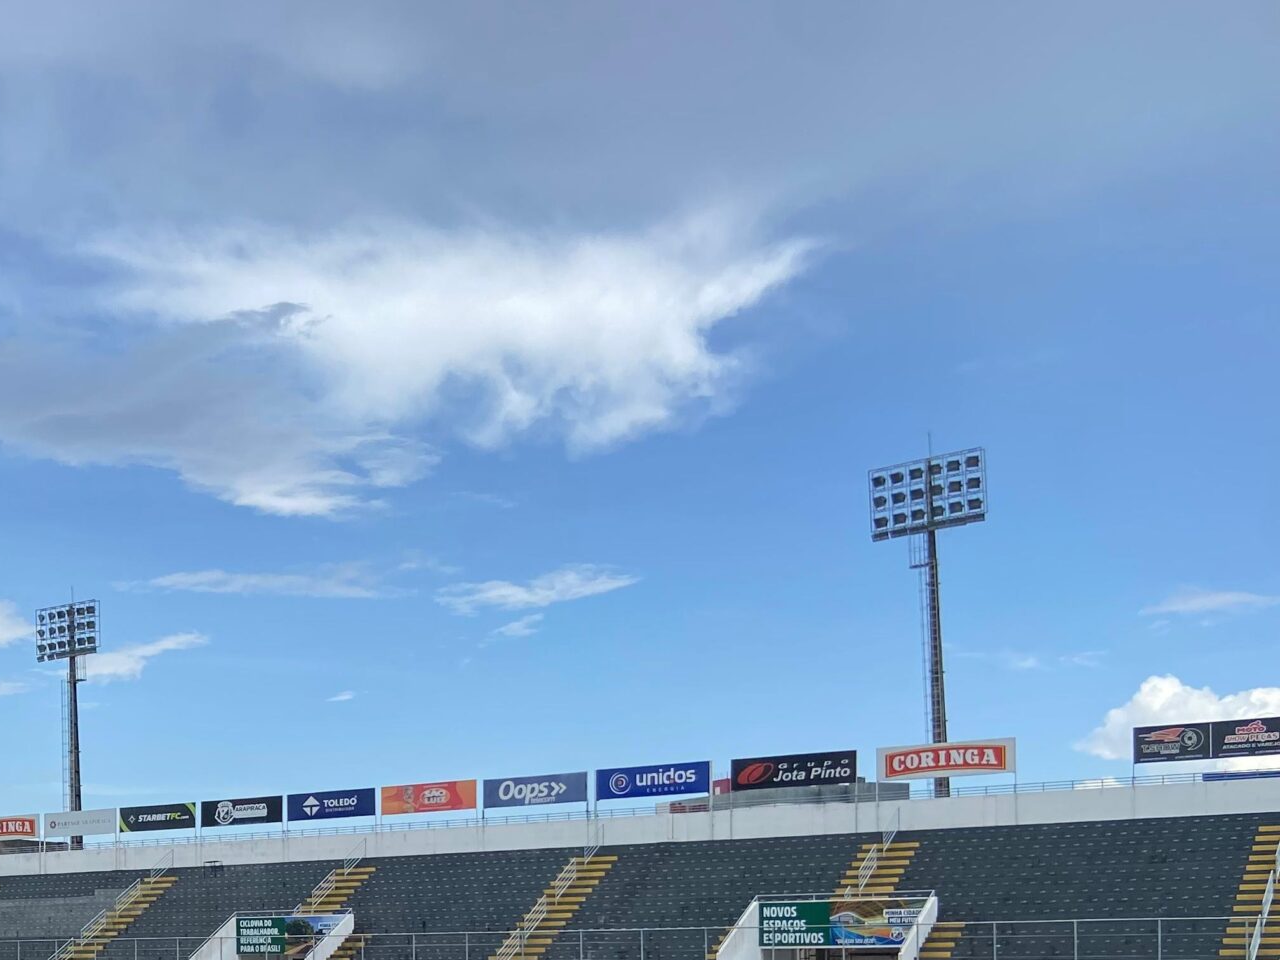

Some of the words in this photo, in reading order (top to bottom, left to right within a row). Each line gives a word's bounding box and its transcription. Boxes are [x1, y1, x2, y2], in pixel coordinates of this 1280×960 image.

[1235, 726, 1265, 734] MOTO
[1224, 734, 1248, 743] SHOW
[892, 748, 998, 772] CORINGA
[635, 767, 696, 787] unidos
[773, 769, 806, 783] Jota
[809, 766, 851, 780] Pinto
[498, 780, 550, 804] Oops
[323, 798, 357, 807] TOLEDO
[763, 906, 797, 918] NOVOS
[240, 919, 264, 927] CICLOVIA
[264, 919, 272, 927] DO
[763, 919, 806, 932] ESPAÇOS
[763, 932, 824, 944] ESPORTIVOS
[240, 944, 254, 953] PARA
